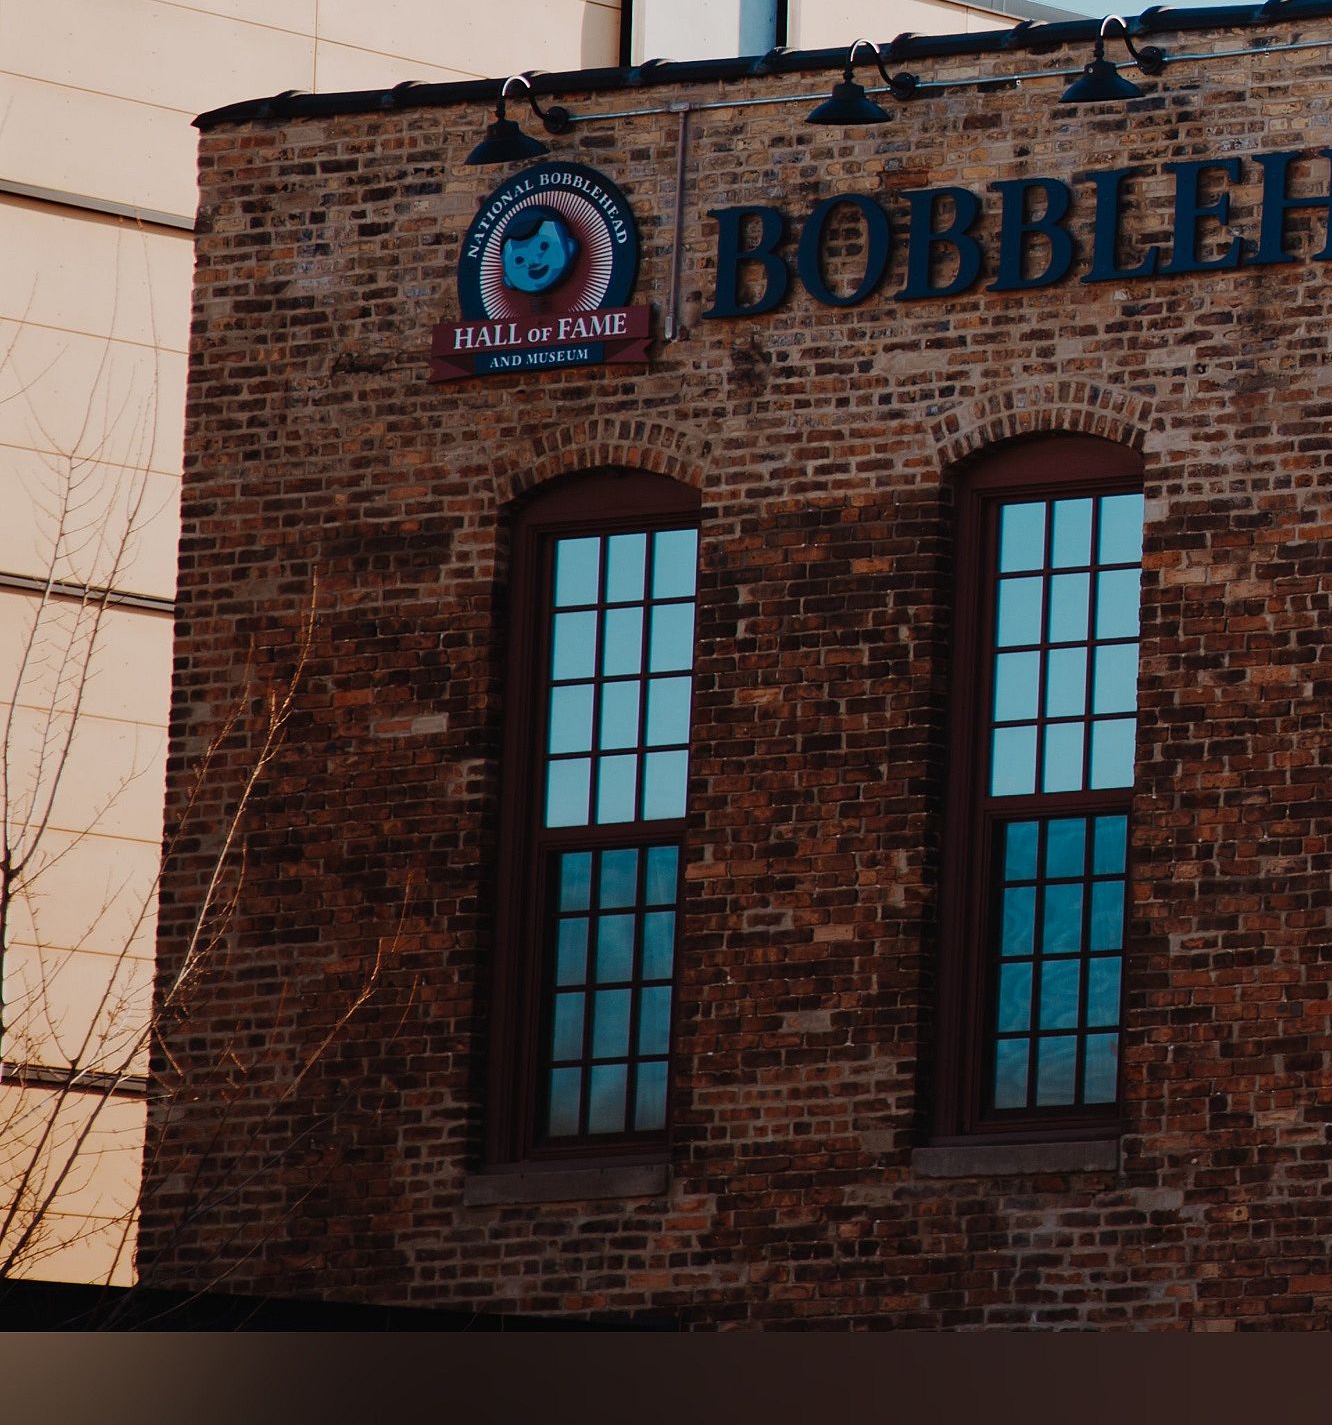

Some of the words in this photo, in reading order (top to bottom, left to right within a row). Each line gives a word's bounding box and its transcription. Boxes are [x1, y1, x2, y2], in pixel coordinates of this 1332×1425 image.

[467, 179, 535, 259] NATIONAL
[539, 172, 628, 245] BOBBLEHEAD
[453, 323, 523, 350] HALL
[557, 312, 628, 341] FAME
[489, 354, 523, 369] AND
[526, 348, 589, 365] MUSEUM
